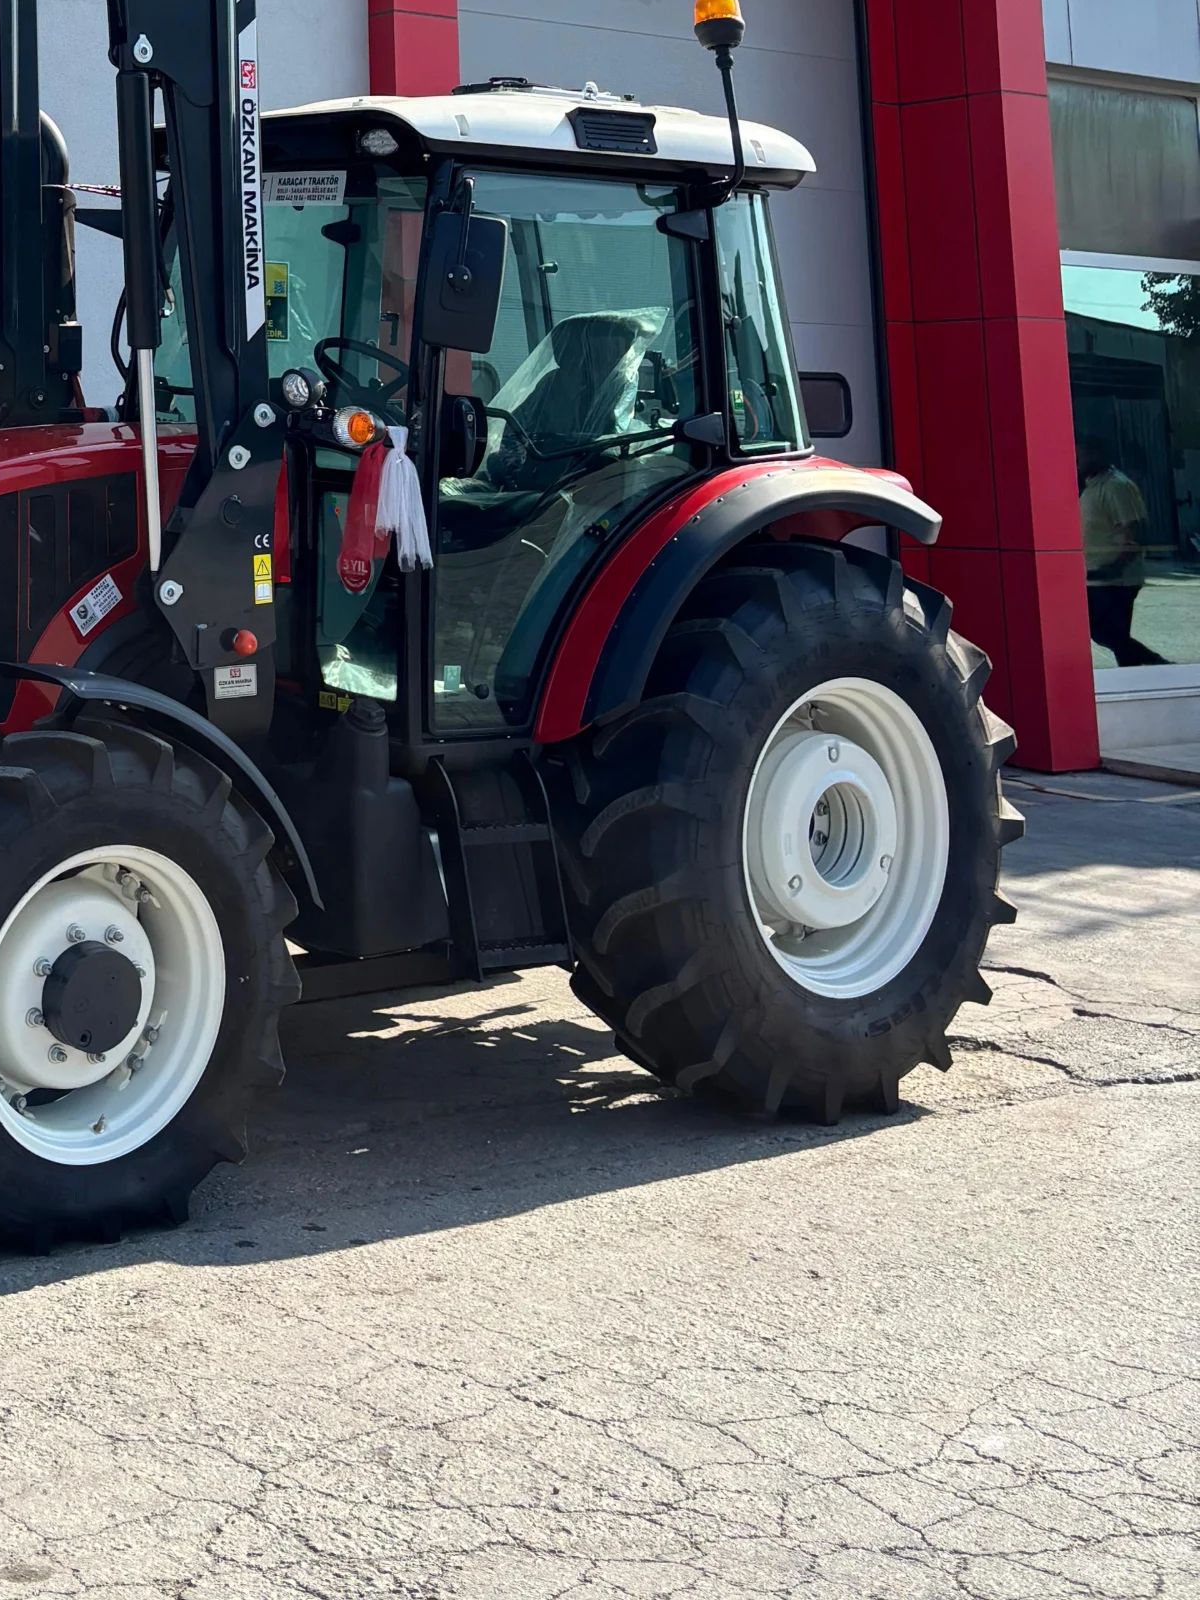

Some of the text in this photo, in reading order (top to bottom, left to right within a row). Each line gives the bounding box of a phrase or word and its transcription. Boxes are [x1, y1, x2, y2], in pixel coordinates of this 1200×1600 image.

[278, 177, 308, 186] KARAÇAY
[309, 175, 339, 185] TRAKTÖR
[242, 98, 261, 290] ÖZKAN MAKİNA
[254, 533, 270, 549] CE
[343, 559, 368, 573] 3 YIL
